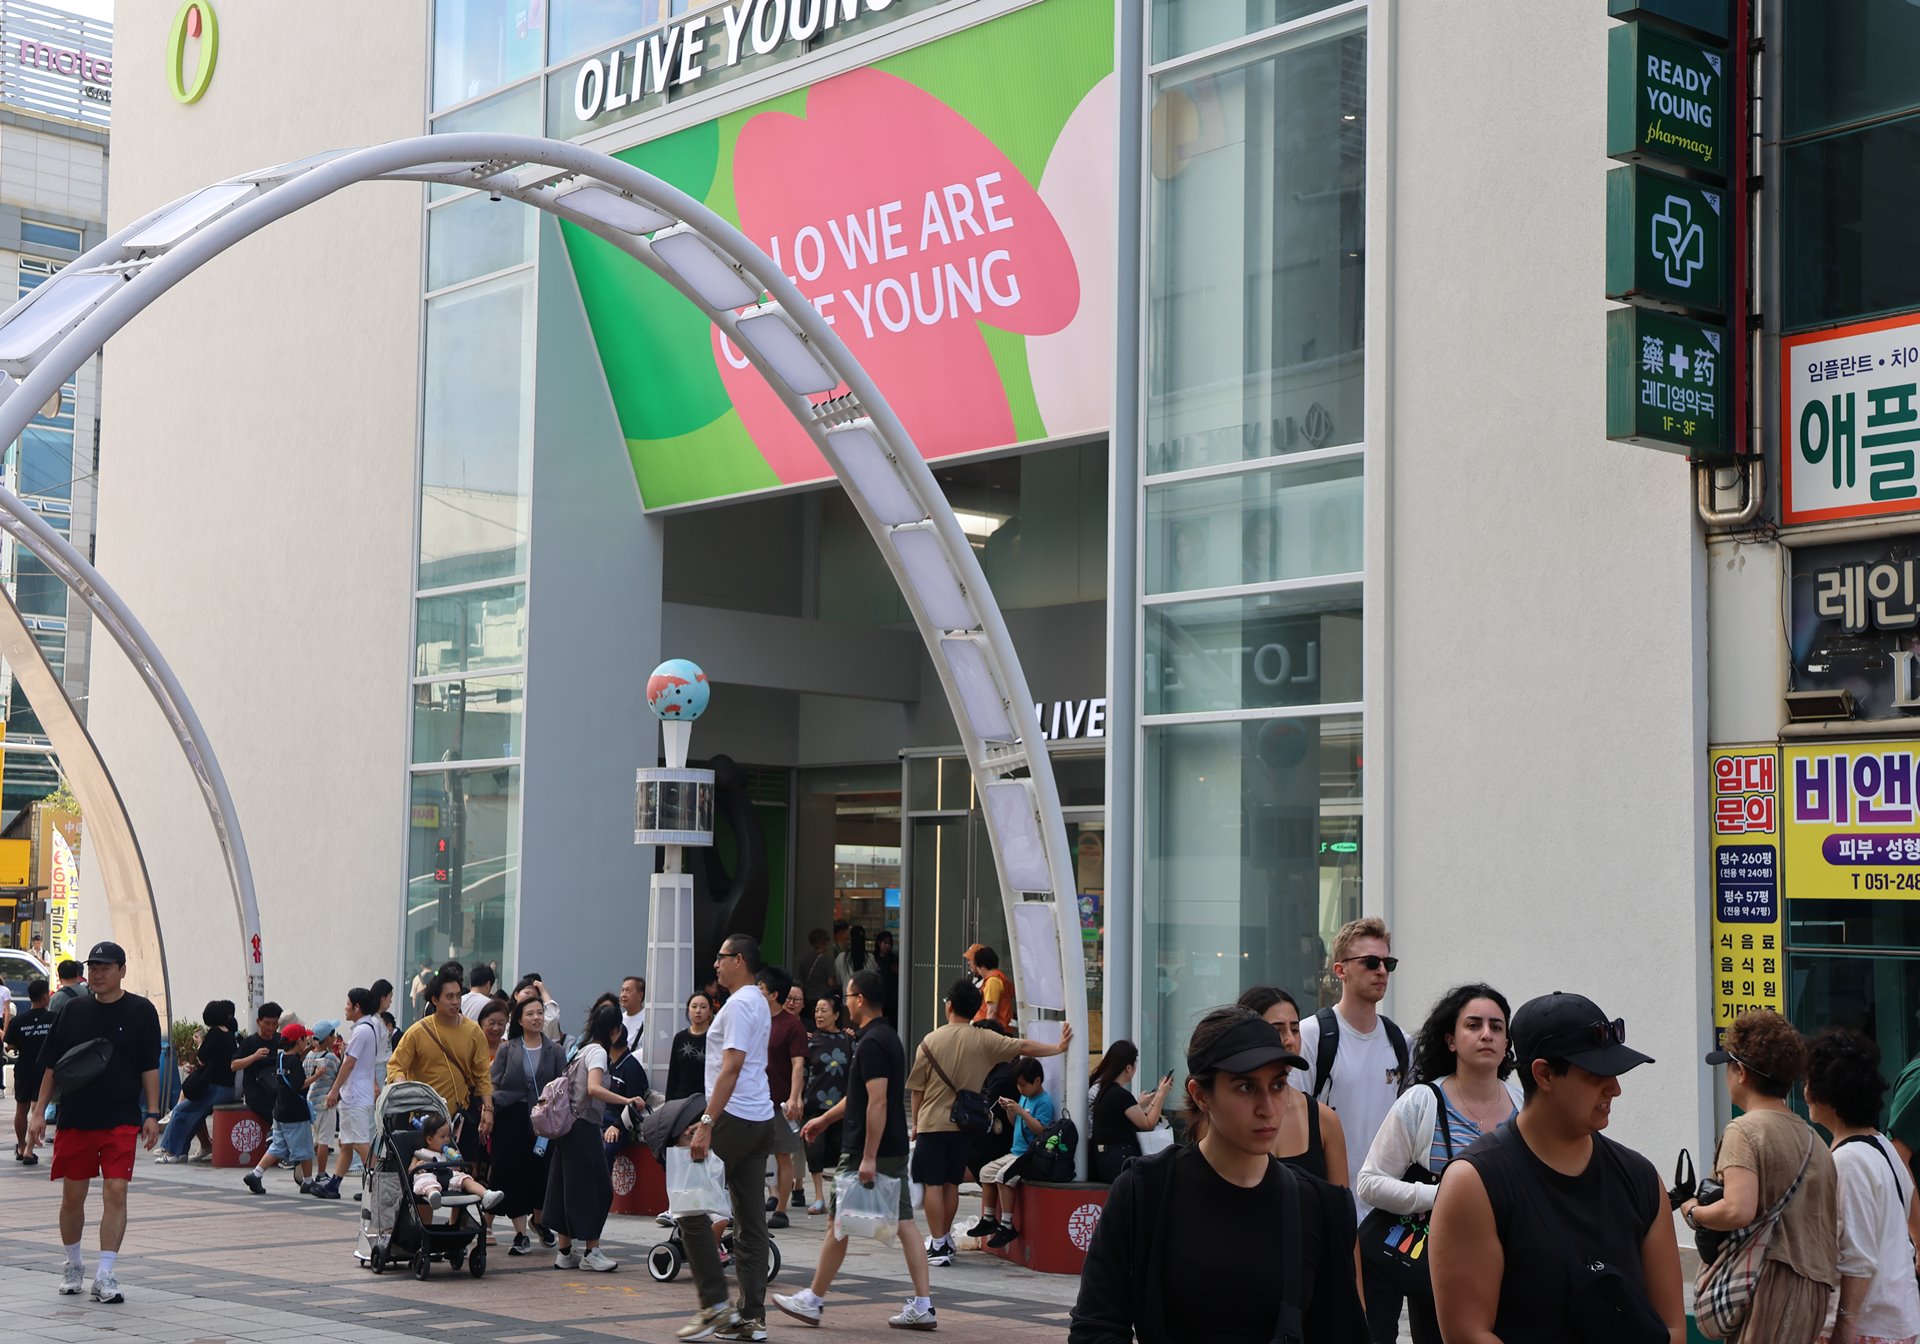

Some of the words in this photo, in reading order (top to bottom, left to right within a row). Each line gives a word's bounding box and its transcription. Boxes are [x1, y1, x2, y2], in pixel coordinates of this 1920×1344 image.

[573, 15, 710, 121] OLIVE
[722, 0, 893, 67] YOU
[1647, 54, 1712, 96] READY
[1647, 86, 1712, 128] YOUNG
[1645, 119, 1713, 162] pharmacy
[828, 200, 908, 271] WE
[919, 171, 1014, 252] ARE
[842, 249, 1022, 339] YOUNG
[1642, 335, 1664, 375] 藥
[1694, 348, 1715, 388] 药
[1808, 354, 1873, 383] 임플란트
[1641, 379, 1715, 420] 레디영약국
[1662, 415, 1674, 432] 1F
[1683, 420, 1696, 436] 3F
[1799, 382, 1920, 502] 애플
[1817, 559, 1920, 630] 레인
[1034, 698, 1107, 741] LIVE
[1715, 755, 1775, 793] 임대
[1793, 752, 1920, 825] 비앤
[1715, 796, 1775, 833] 문의
[1720, 852, 1740, 865] 평수
[1741, 852, 1772, 865] 260평
[1724, 890, 1744, 903] 평수
[1746, 890, 1769, 903] 57평
[1851, 873, 1860, 890] T
[1722, 1003, 1776, 1019] 기타
